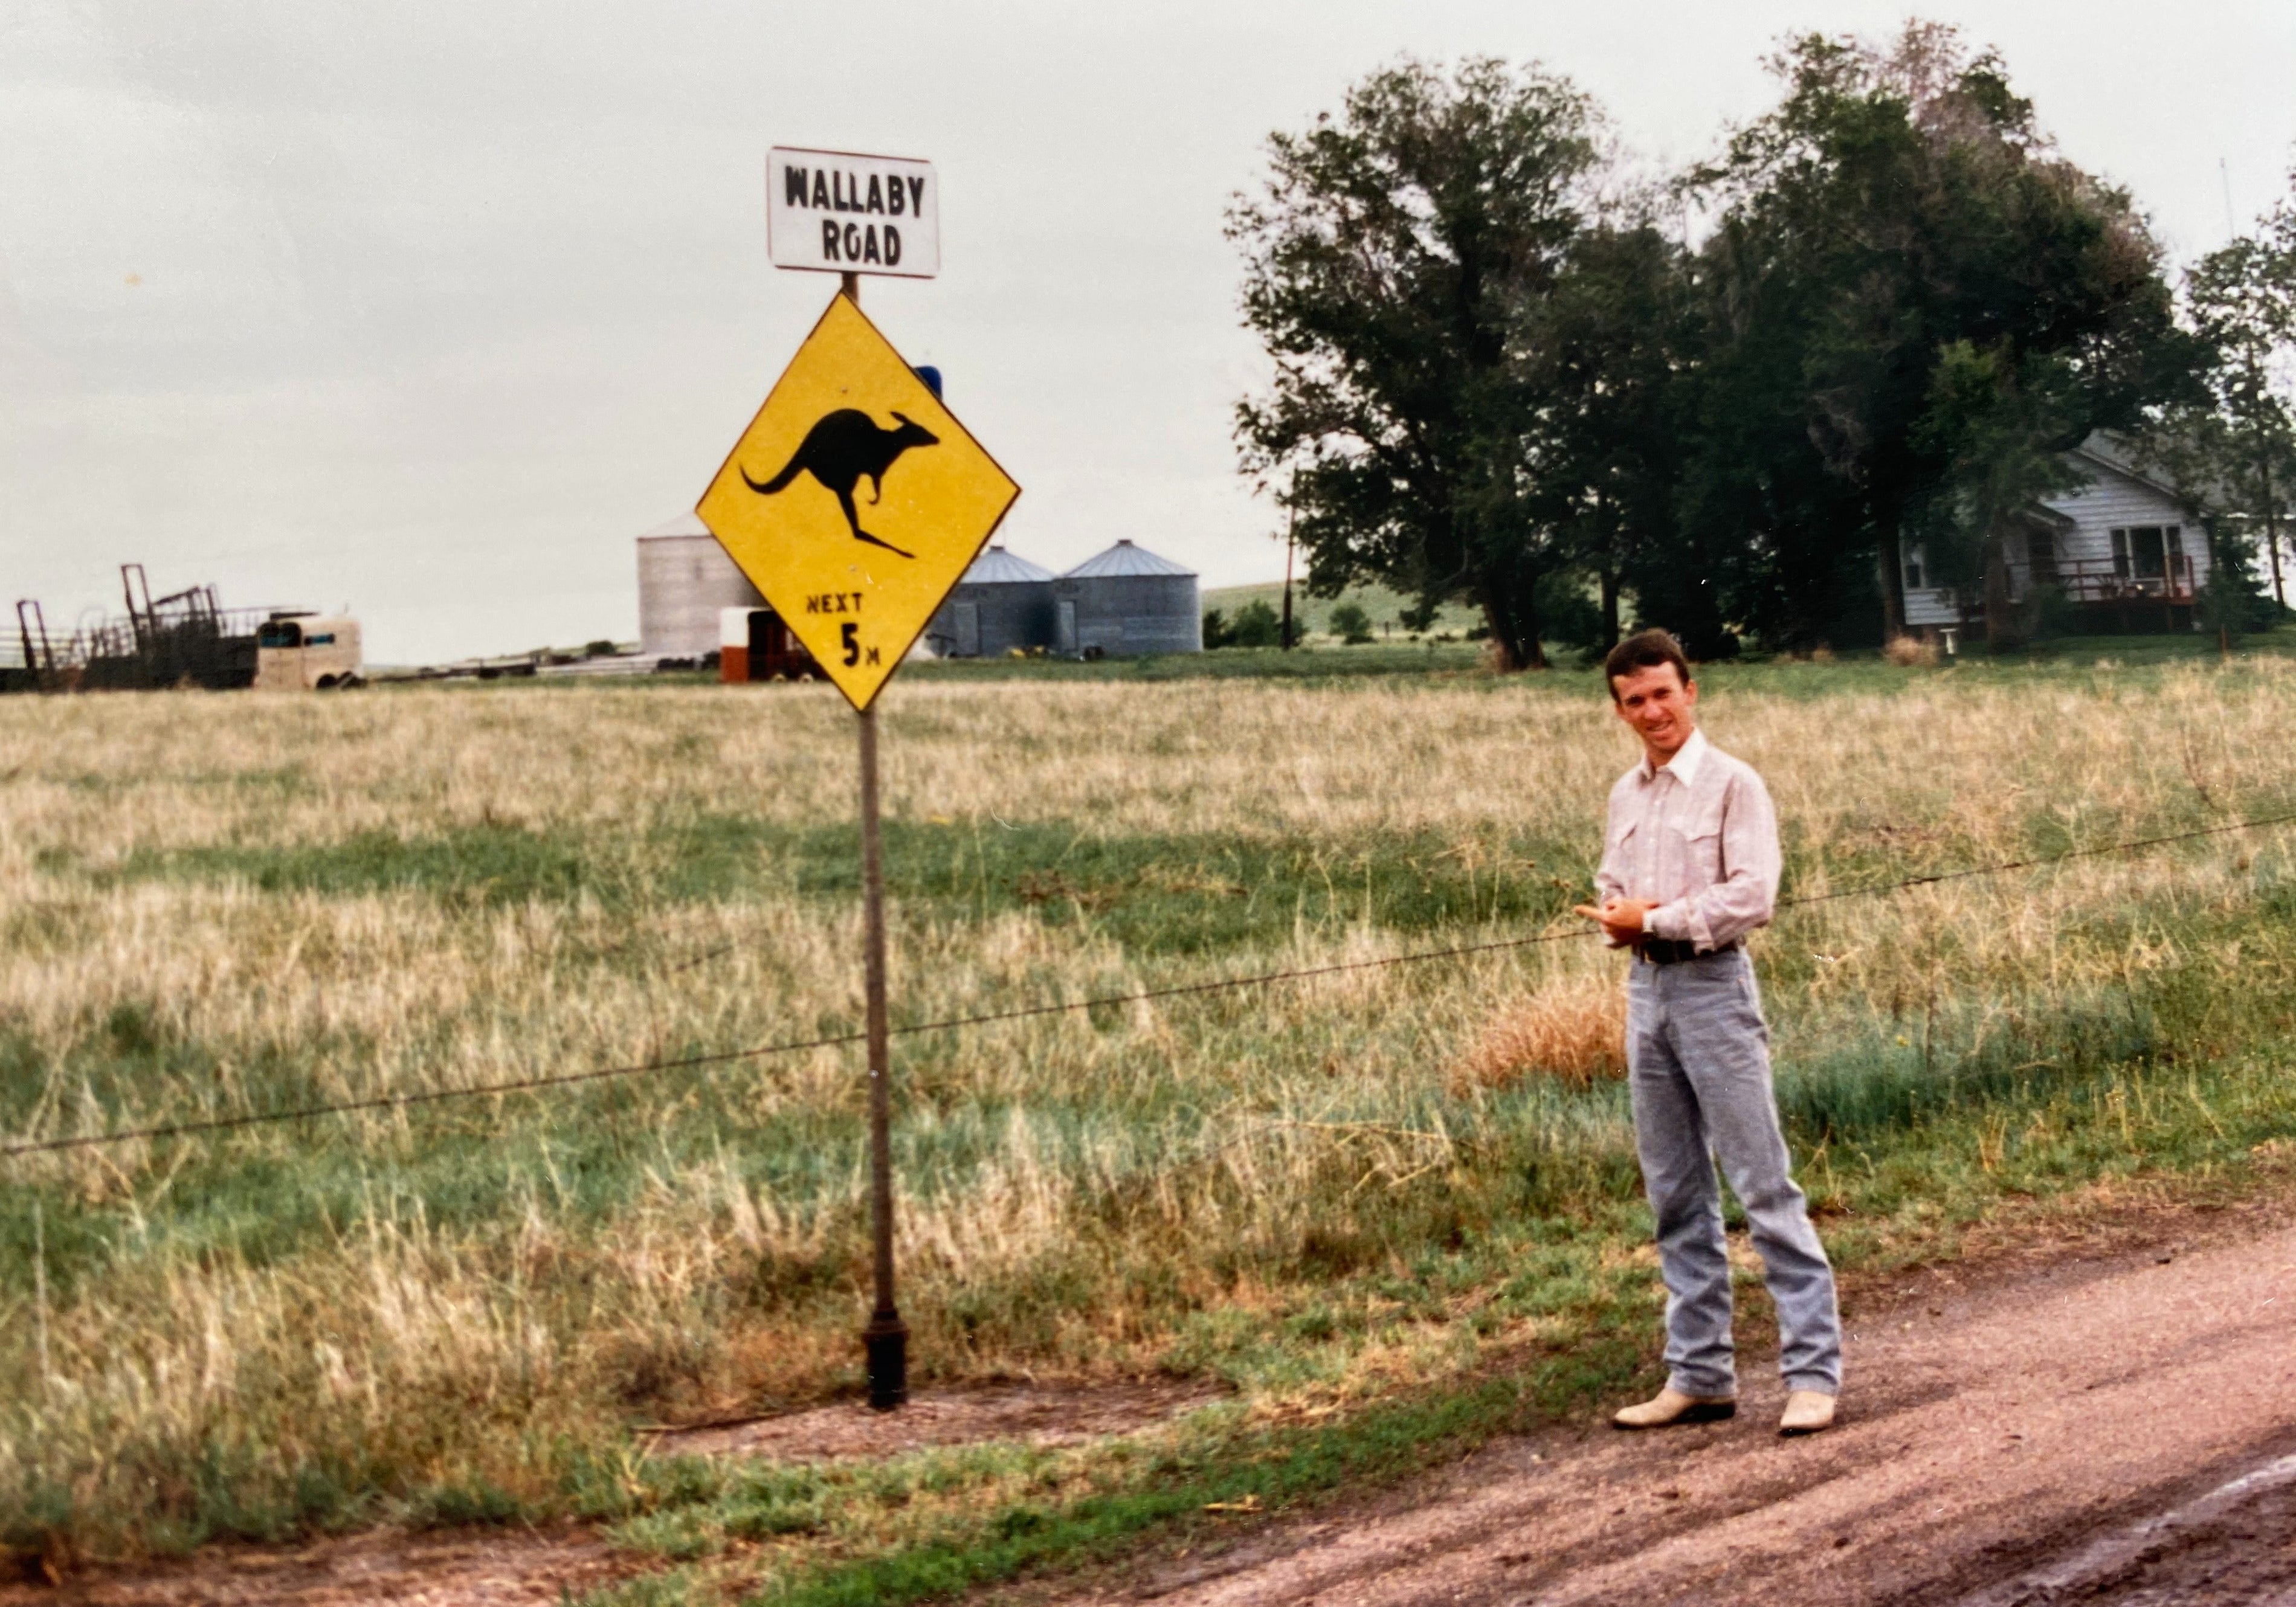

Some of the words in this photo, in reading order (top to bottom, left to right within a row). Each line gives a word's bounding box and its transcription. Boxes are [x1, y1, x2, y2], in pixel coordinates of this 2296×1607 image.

[785, 165, 924, 218] WALLABY
[822, 219, 901, 266] ROAD
[807, 592, 862, 614] NEXT
